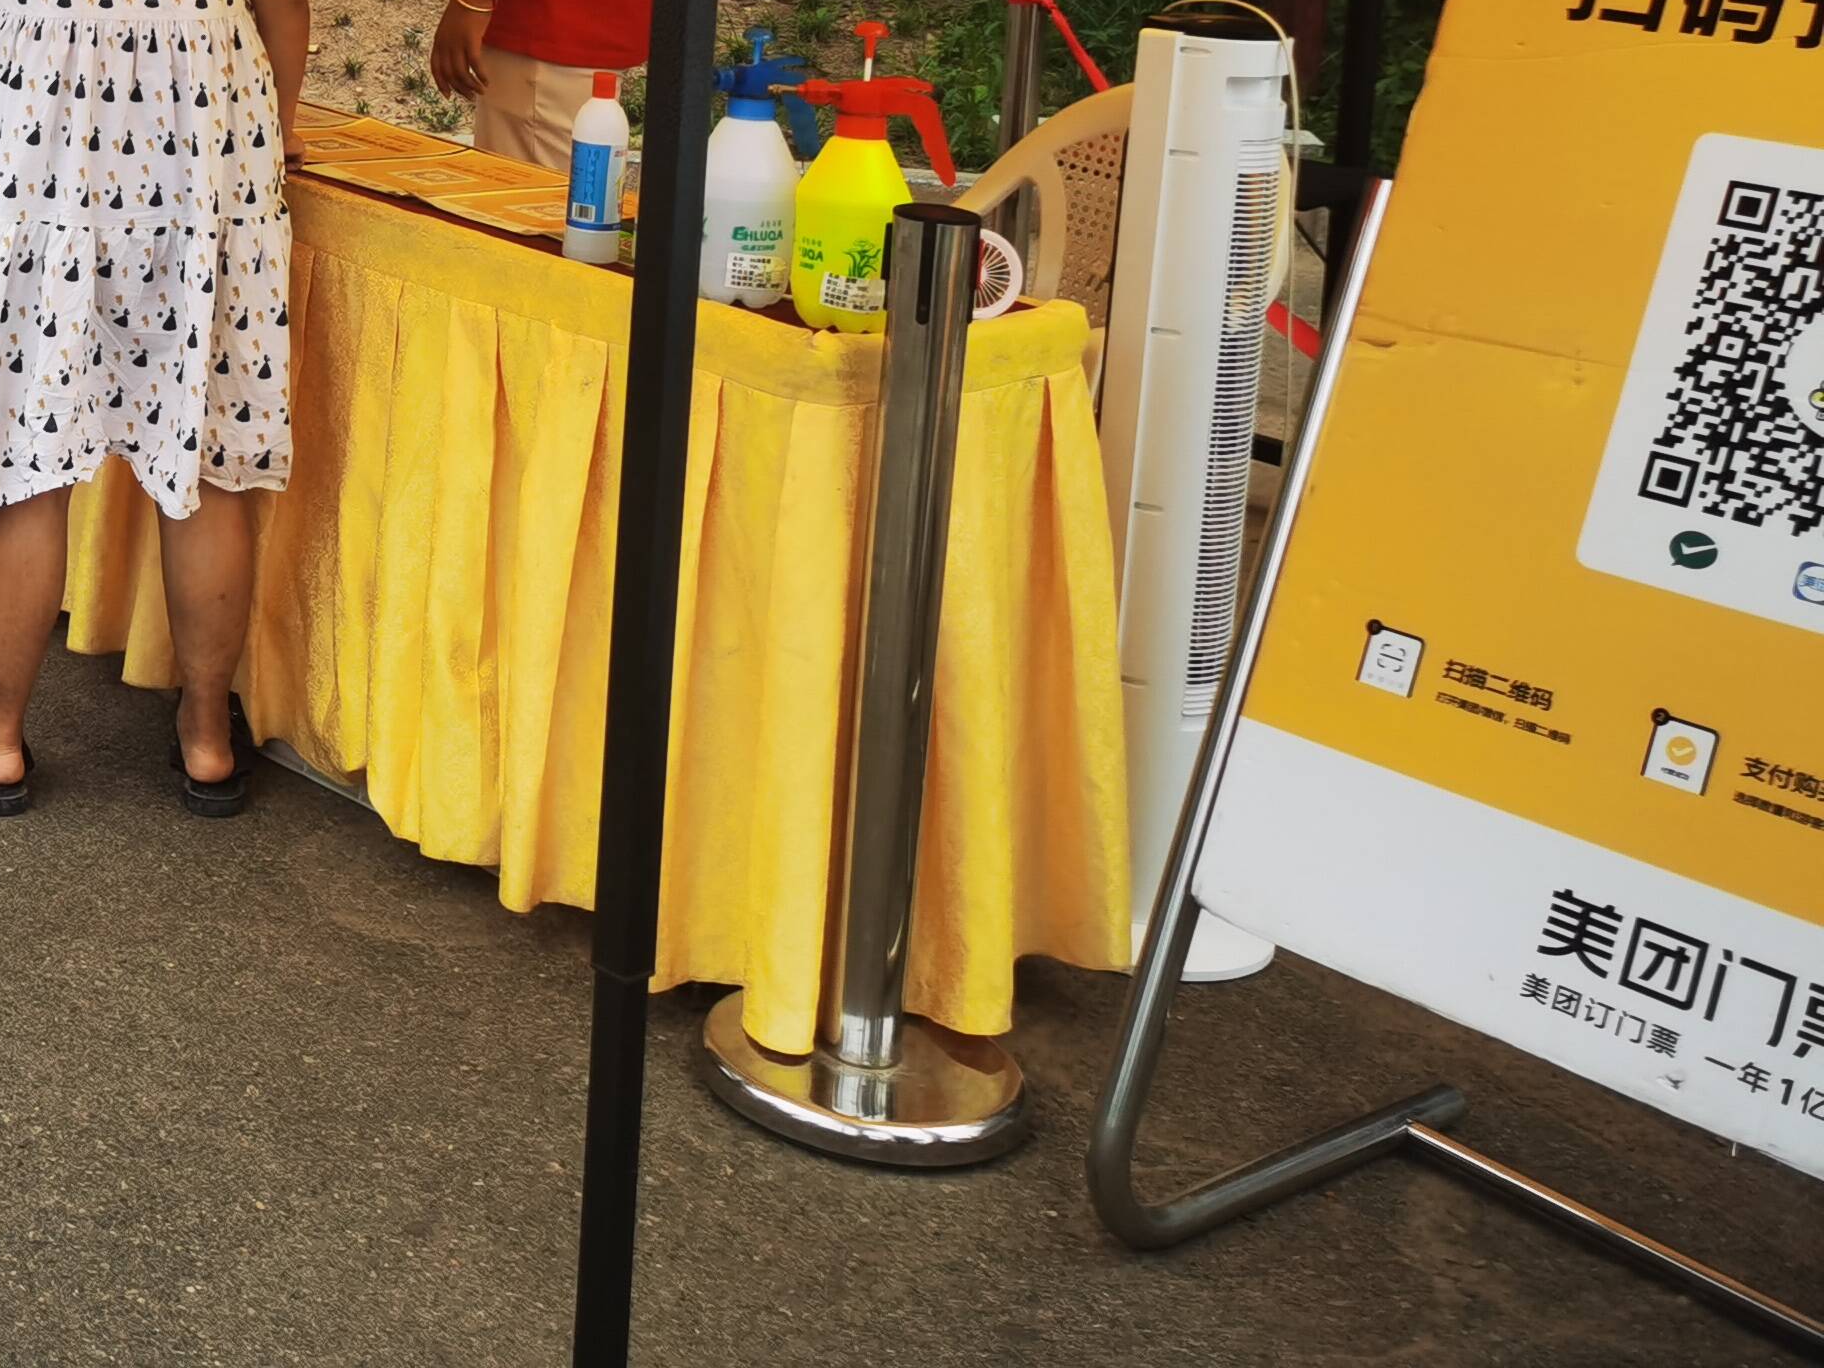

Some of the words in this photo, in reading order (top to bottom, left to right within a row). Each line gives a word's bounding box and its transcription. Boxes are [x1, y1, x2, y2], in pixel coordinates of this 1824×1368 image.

[1442, 659, 1554, 711] 扫描二维码
[1739, 757, 1824, 802] 支付购
[1519, 972, 1682, 1058] 美团订门票
